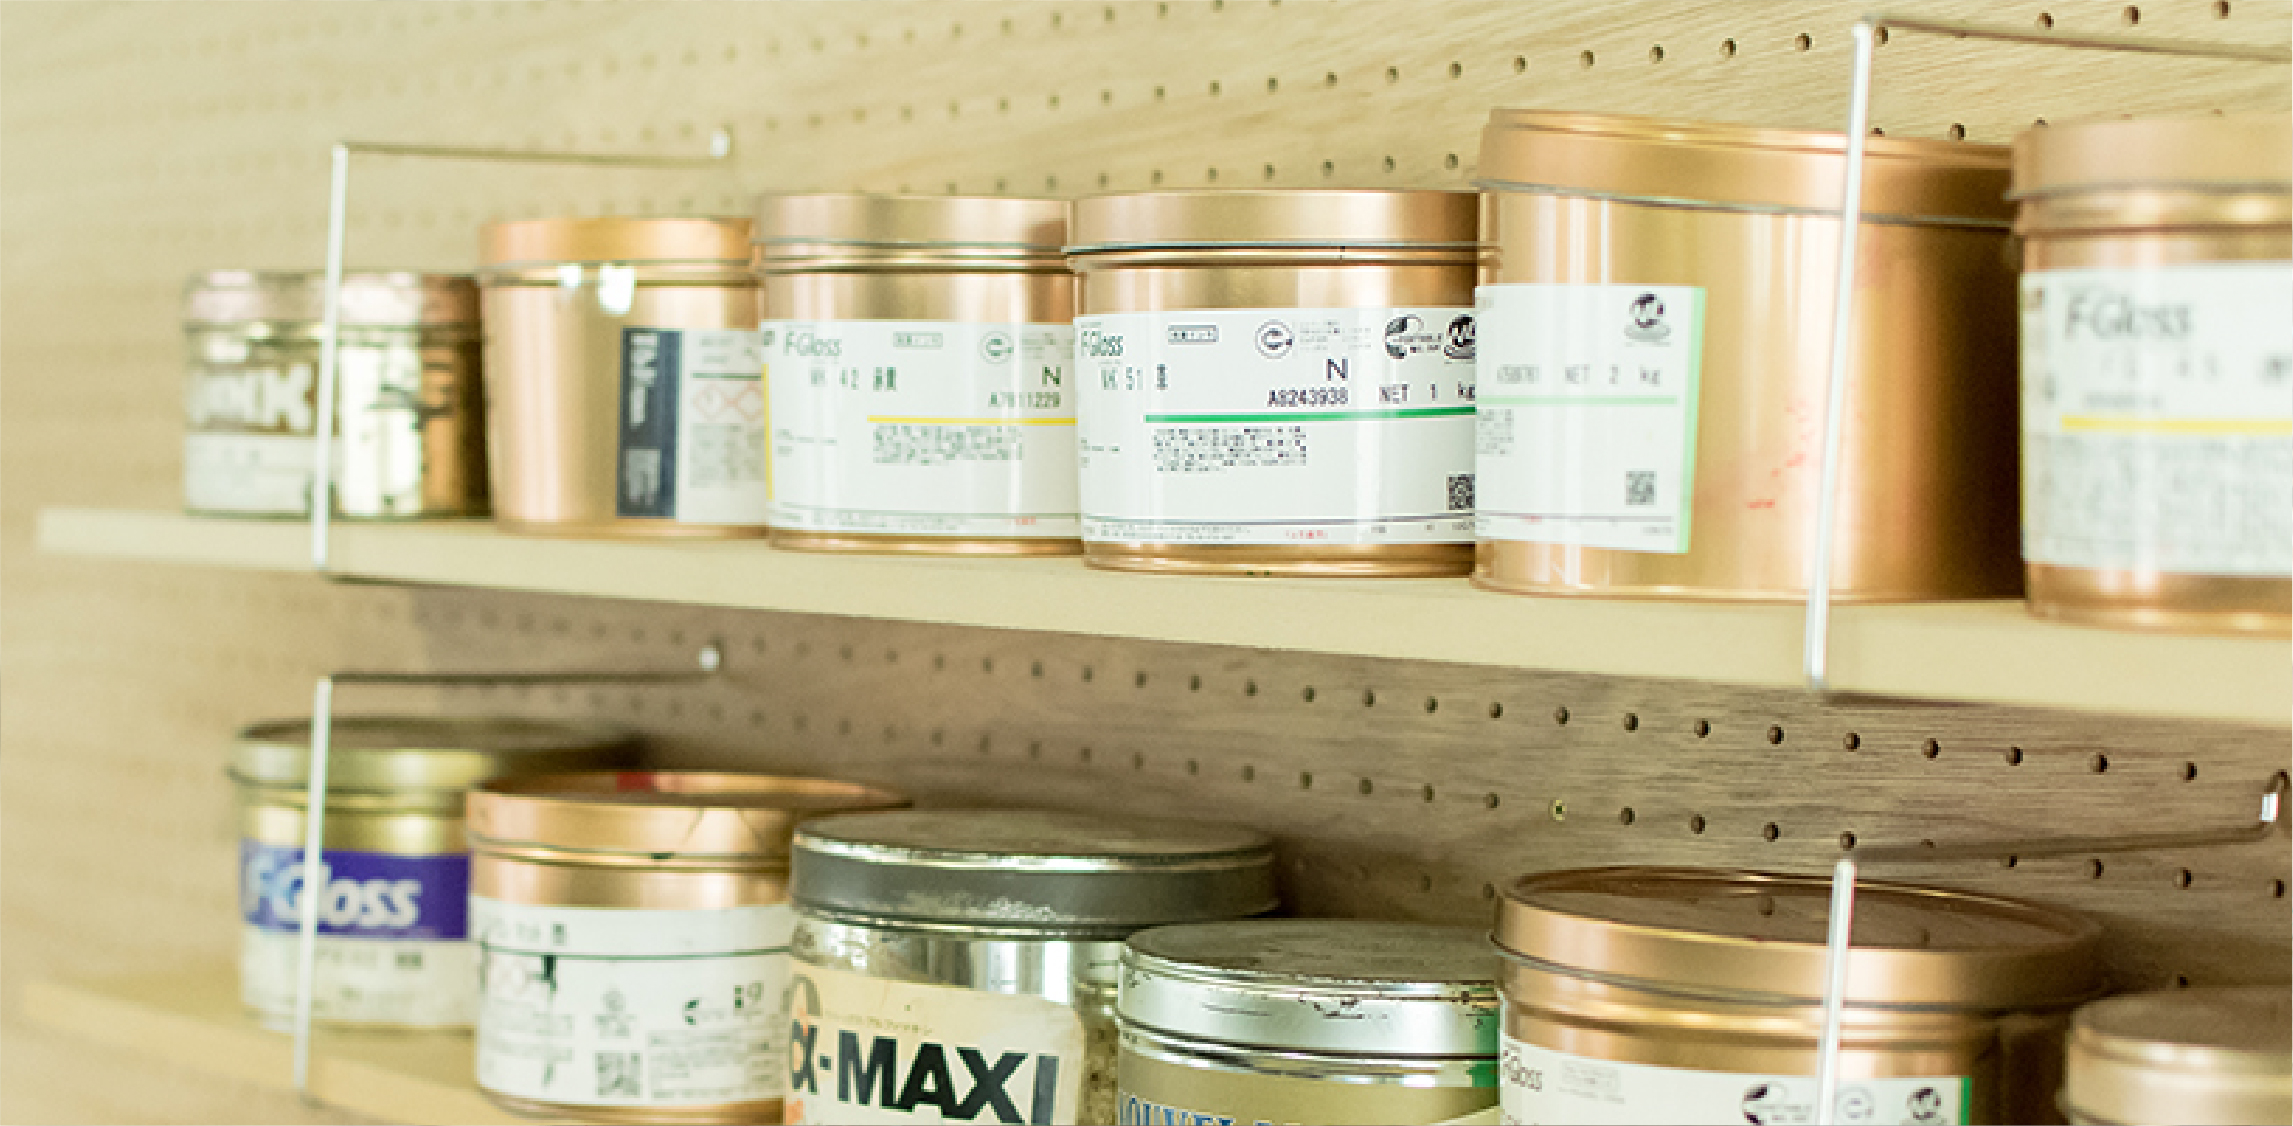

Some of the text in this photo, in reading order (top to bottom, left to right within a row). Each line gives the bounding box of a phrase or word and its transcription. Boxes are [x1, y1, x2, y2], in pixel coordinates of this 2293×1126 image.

[1041, 366, 1062, 386] N
[1325, 358, 1349, 381] N
[1608, 364, 1619, 384] 2
[1640, 364, 1661, 387] kg
[1379, 384, 1408, 403] NET
